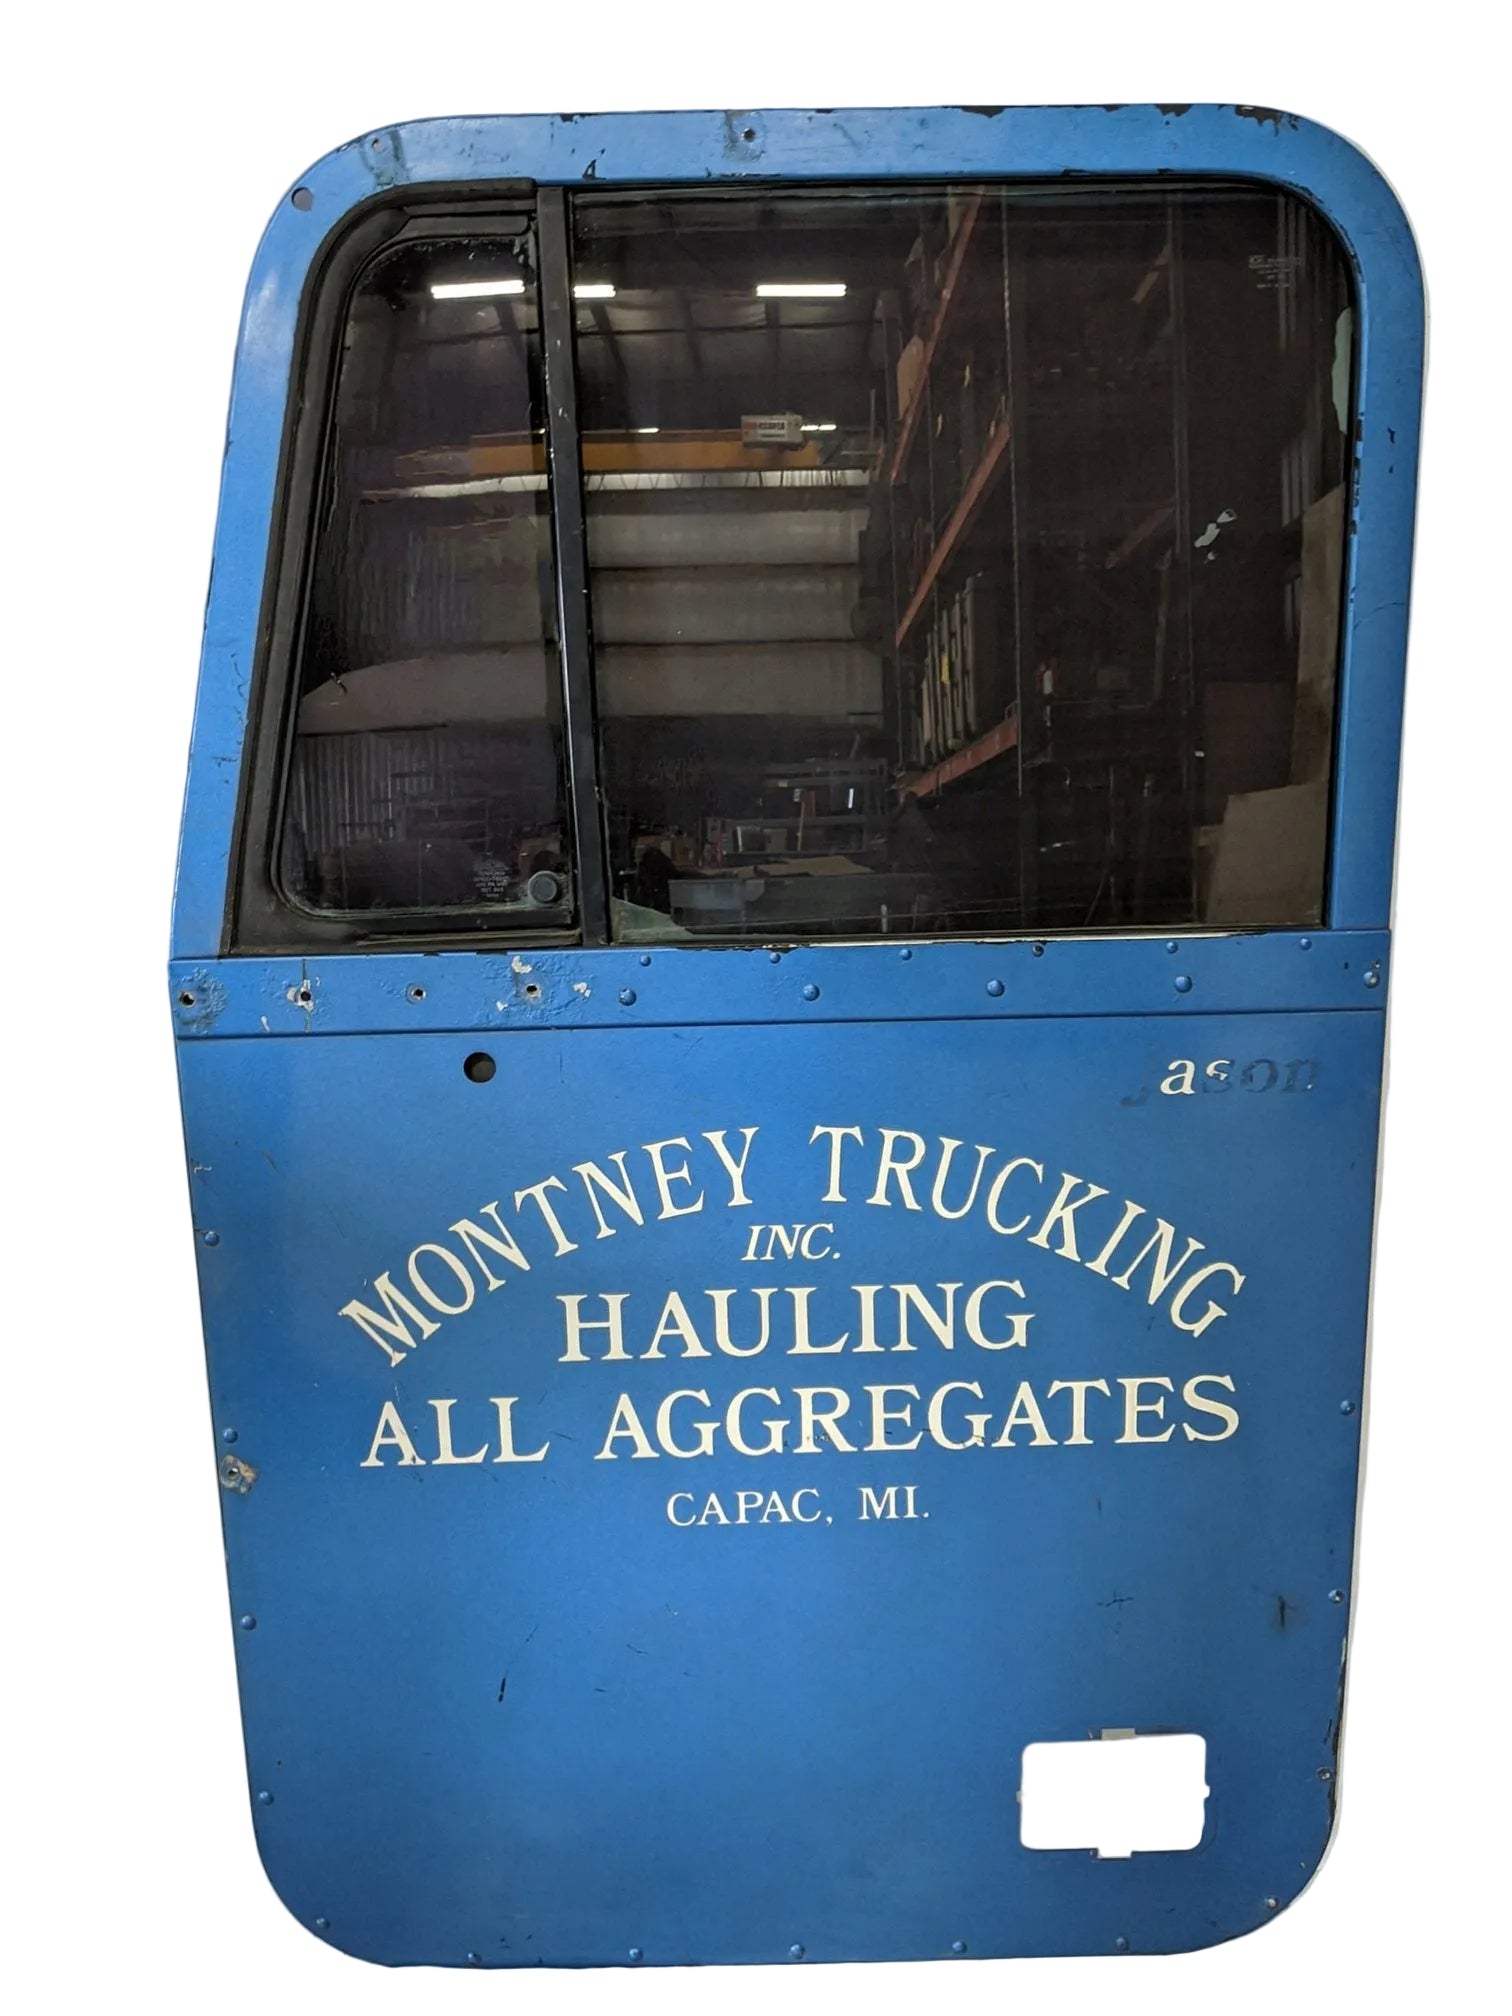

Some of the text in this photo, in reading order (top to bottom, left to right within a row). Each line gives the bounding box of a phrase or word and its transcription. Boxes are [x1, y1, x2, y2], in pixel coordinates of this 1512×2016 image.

[338, 1124, 1246, 1368] MONTNEY TRUCKING
[741, 1223, 841, 1261] INC.
[556, 1280, 1035, 1362] HAULING
[360, 1374, 1240, 1468] ALL AGGREGATES
[666, 1486, 930, 1528] CAPAC, MI.
